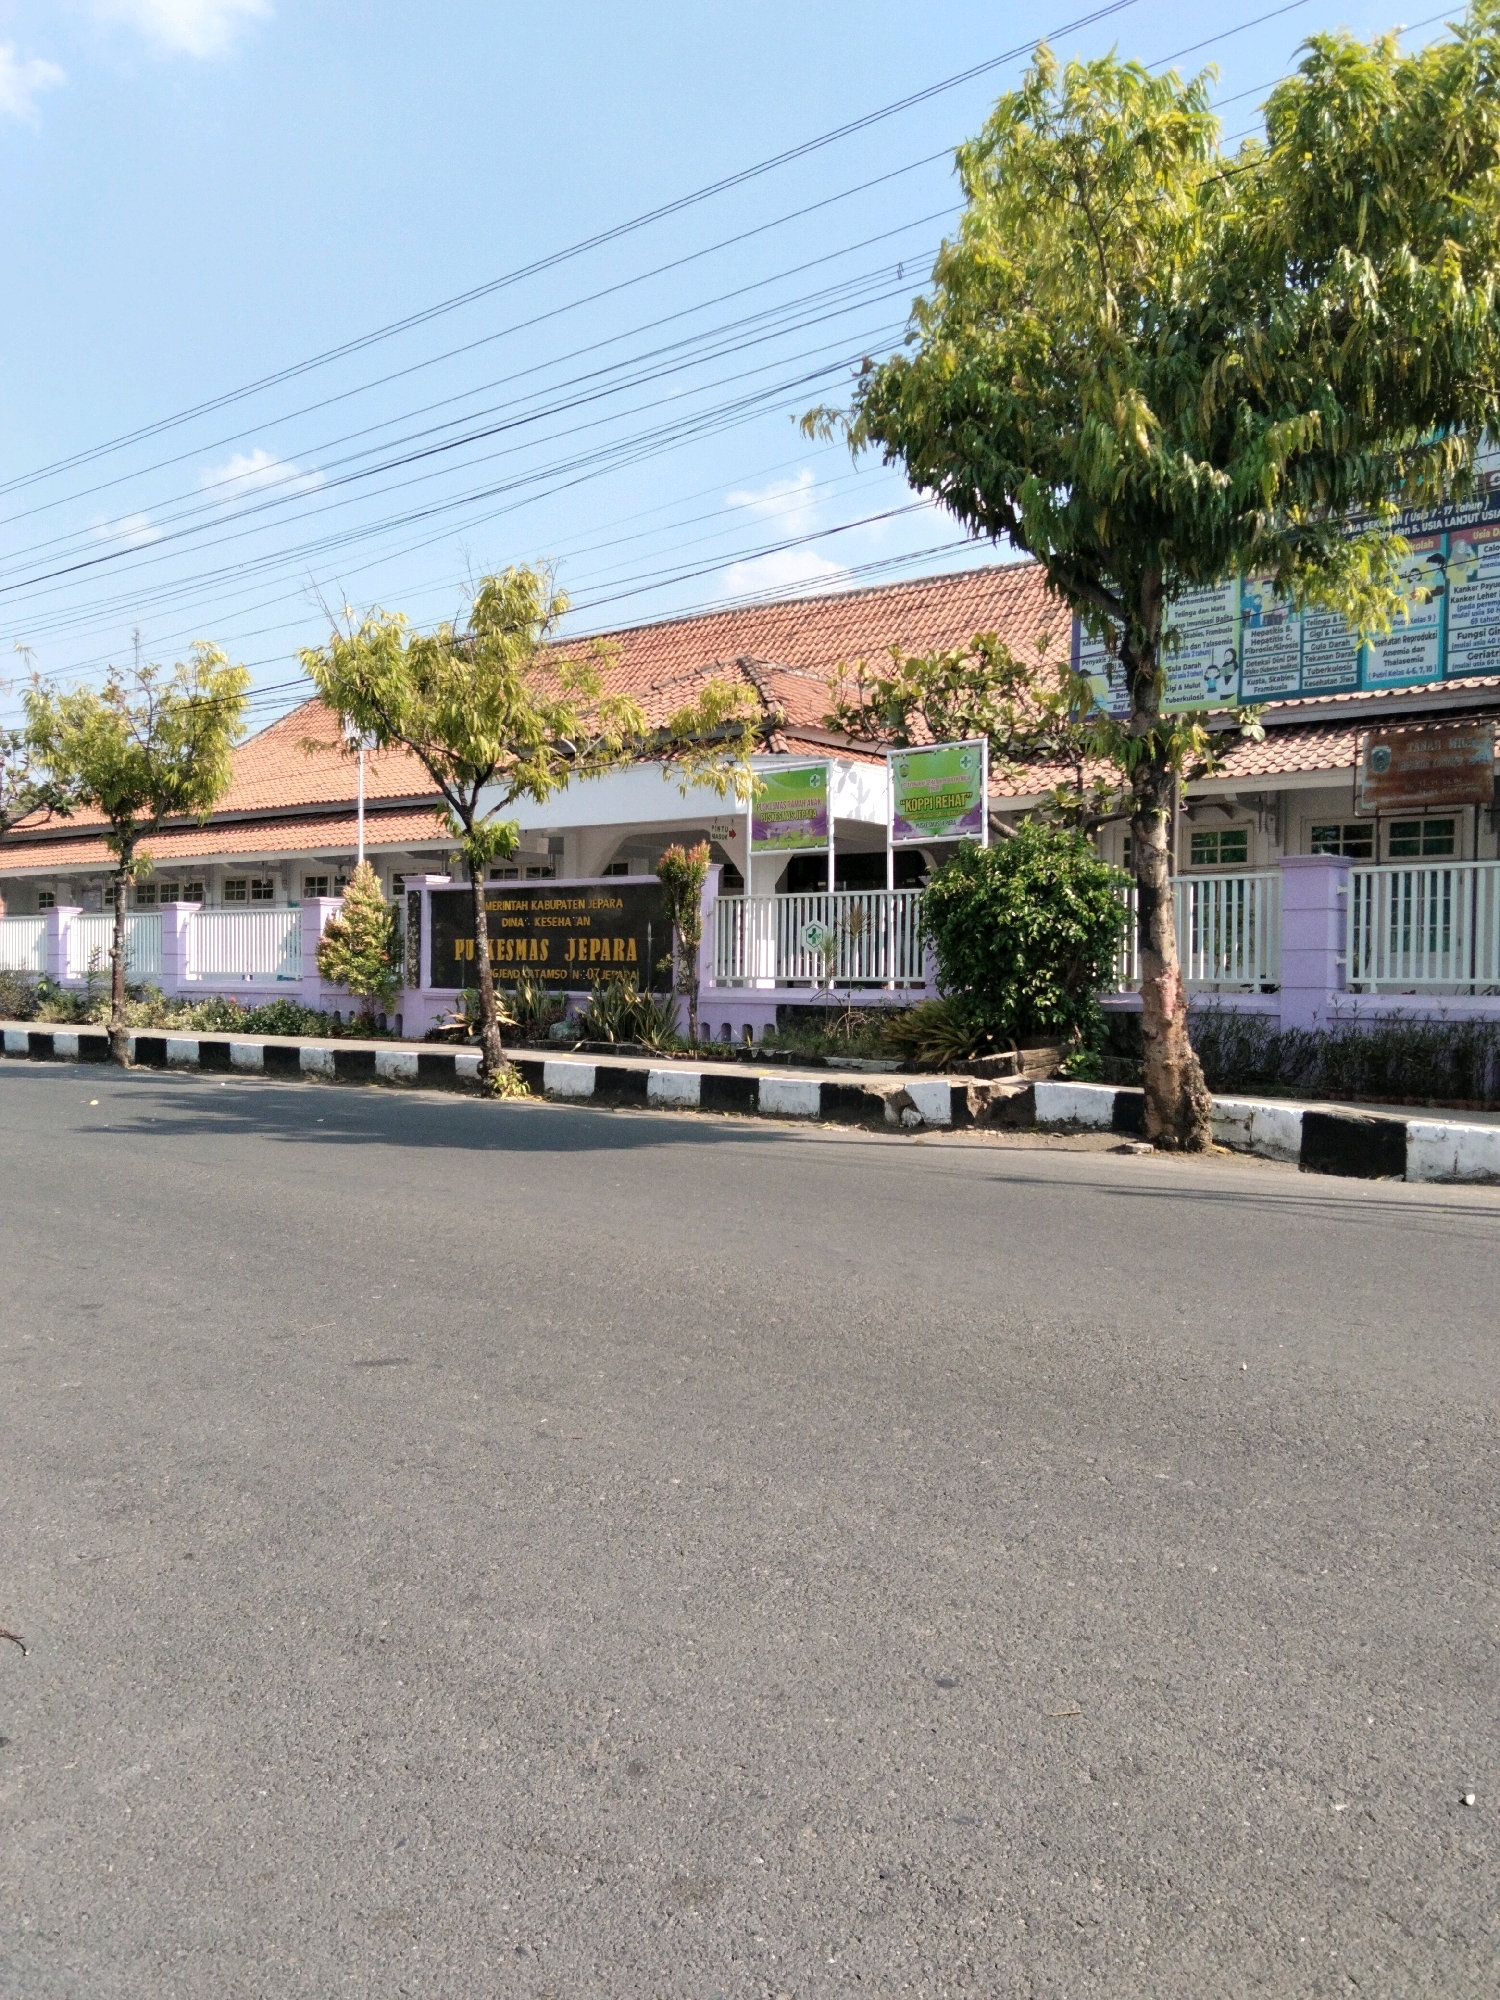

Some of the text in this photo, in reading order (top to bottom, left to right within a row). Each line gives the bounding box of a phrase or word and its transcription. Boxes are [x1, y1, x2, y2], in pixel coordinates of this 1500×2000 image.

[1363, 515, 1403, 531] SEKOAH
[1443, 505, 1454, 515] 17
[1422, 520, 1443, 532] USIA
[1444, 512, 1480, 527] LANJUT
[1481, 508, 1500, 521] USIA
[1473, 528, 1491, 540] Usia
[1410, 540, 1434, 551] kolah
[1453, 584, 1479, 595] Kanker
[1174, 594, 1226, 607] Perkembangan
[1450, 594, 1476, 604] Kanker
[1476, 591, 1498, 601] Leher
[1174, 609, 1197, 619] Telinga
[1198, 607, 1210, 615] dan
[1451, 609, 1471, 619] mulai
[1471, 608, 1485, 617] usia
[1186, 616, 1215, 627] Imunisasi
[1305, 617, 1331, 627] Telinga
[1205, 625, 1233, 637] Frambusia
[1251, 626, 1284, 638] Hepatitis
[1309, 627, 1324, 639] Gigi
[1402, 629, 1438, 644] Reproduksi
[1457, 628, 1487, 640] Fungsi
[1203, 637, 1233, 649] Talasemia
[1251, 634, 1284, 646] Hepatitis
[1310, 639, 1351, 651] Gula Darah
[1472, 639, 1486, 647] usia
[1487, 637, 1496, 645] 40
[1244, 641, 1299, 655] Fibrosis/Sirosis
[1382, 645, 1426, 658] Anemia dan
[1246, 654, 1298, 668] Deteksi Dini DM
[1304, 650, 1356, 663] Tekanan Darah
[1383, 655, 1424, 667] Thalasemia
[1183, 662, 1202, 671] Darah
[1306, 662, 1353, 675] Tuberkulosis
[1372, 669, 1388, 679] Putri
[1388, 669, 1405, 677] Kelas
[1253, 683, 1288, 693] Frambusia
[1304, 678, 1338, 688] Kesehatan
[1165, 693, 1205, 704] Tuberkulosis
[485, 898, 624, 912] MERINTAH KABUPATEN JEPARA
[502, 916, 591, 928] DINA KESEHAAN
[454, 937, 638, 962] PUKESMAS JEPARA
[490, 968, 520, 980] IGJEND
